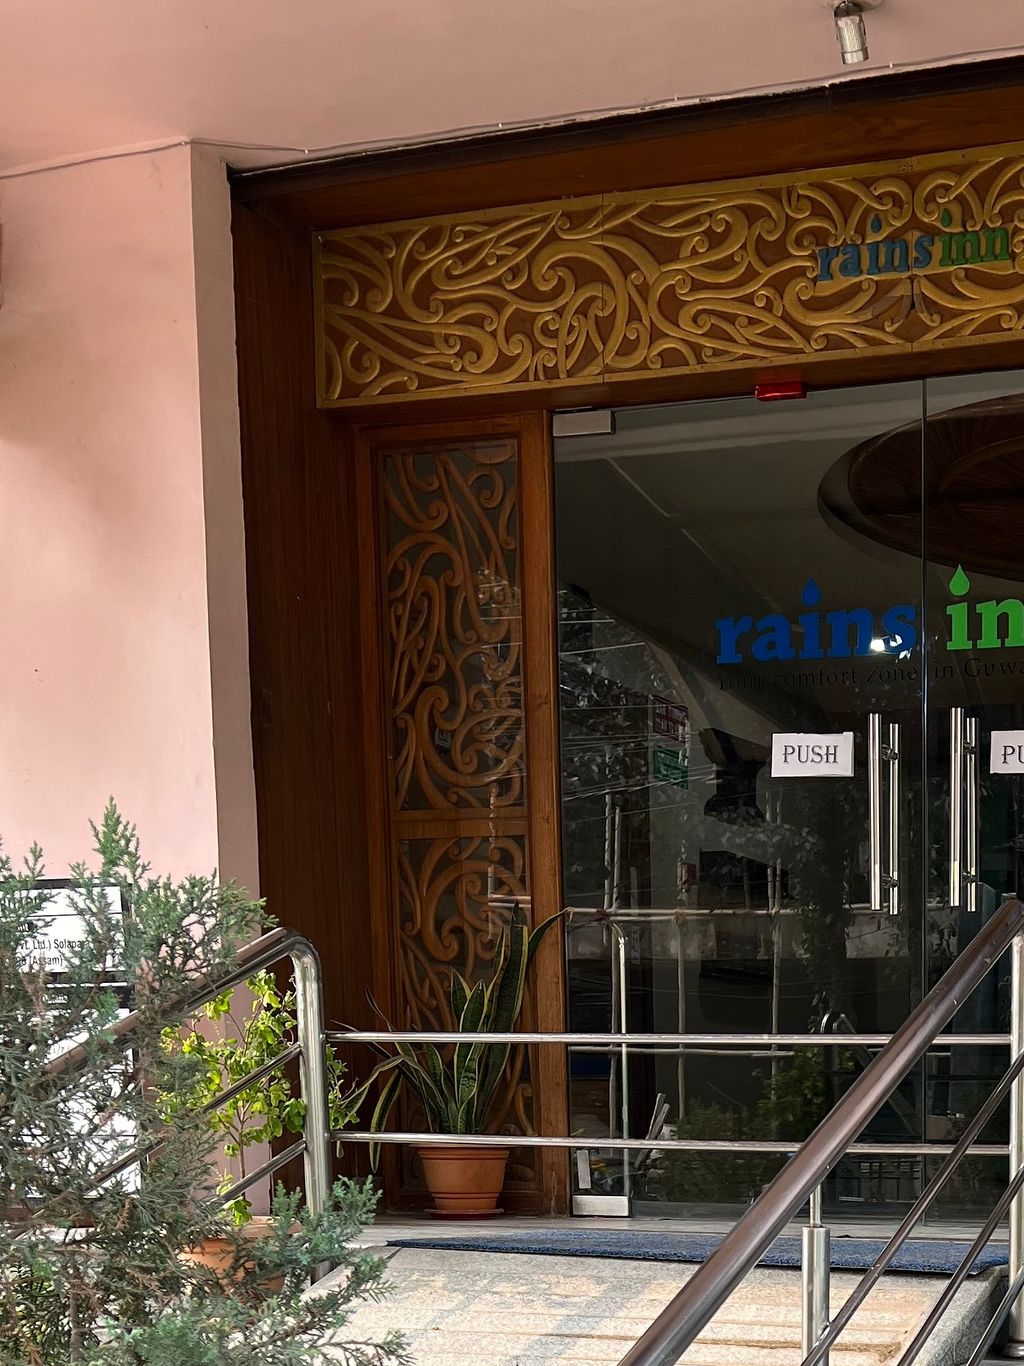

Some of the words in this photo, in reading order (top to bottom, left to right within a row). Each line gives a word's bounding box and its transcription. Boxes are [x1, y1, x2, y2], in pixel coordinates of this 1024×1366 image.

[816, 213, 934, 282] rains
[938, 207, 1011, 268] inn
[715, 576, 917, 665] rains
[773, 667, 857, 688] comfort
[866, 666, 918, 683] zone
[934, 660, 955, 680] in
[782, 744, 840, 765] PUSH
